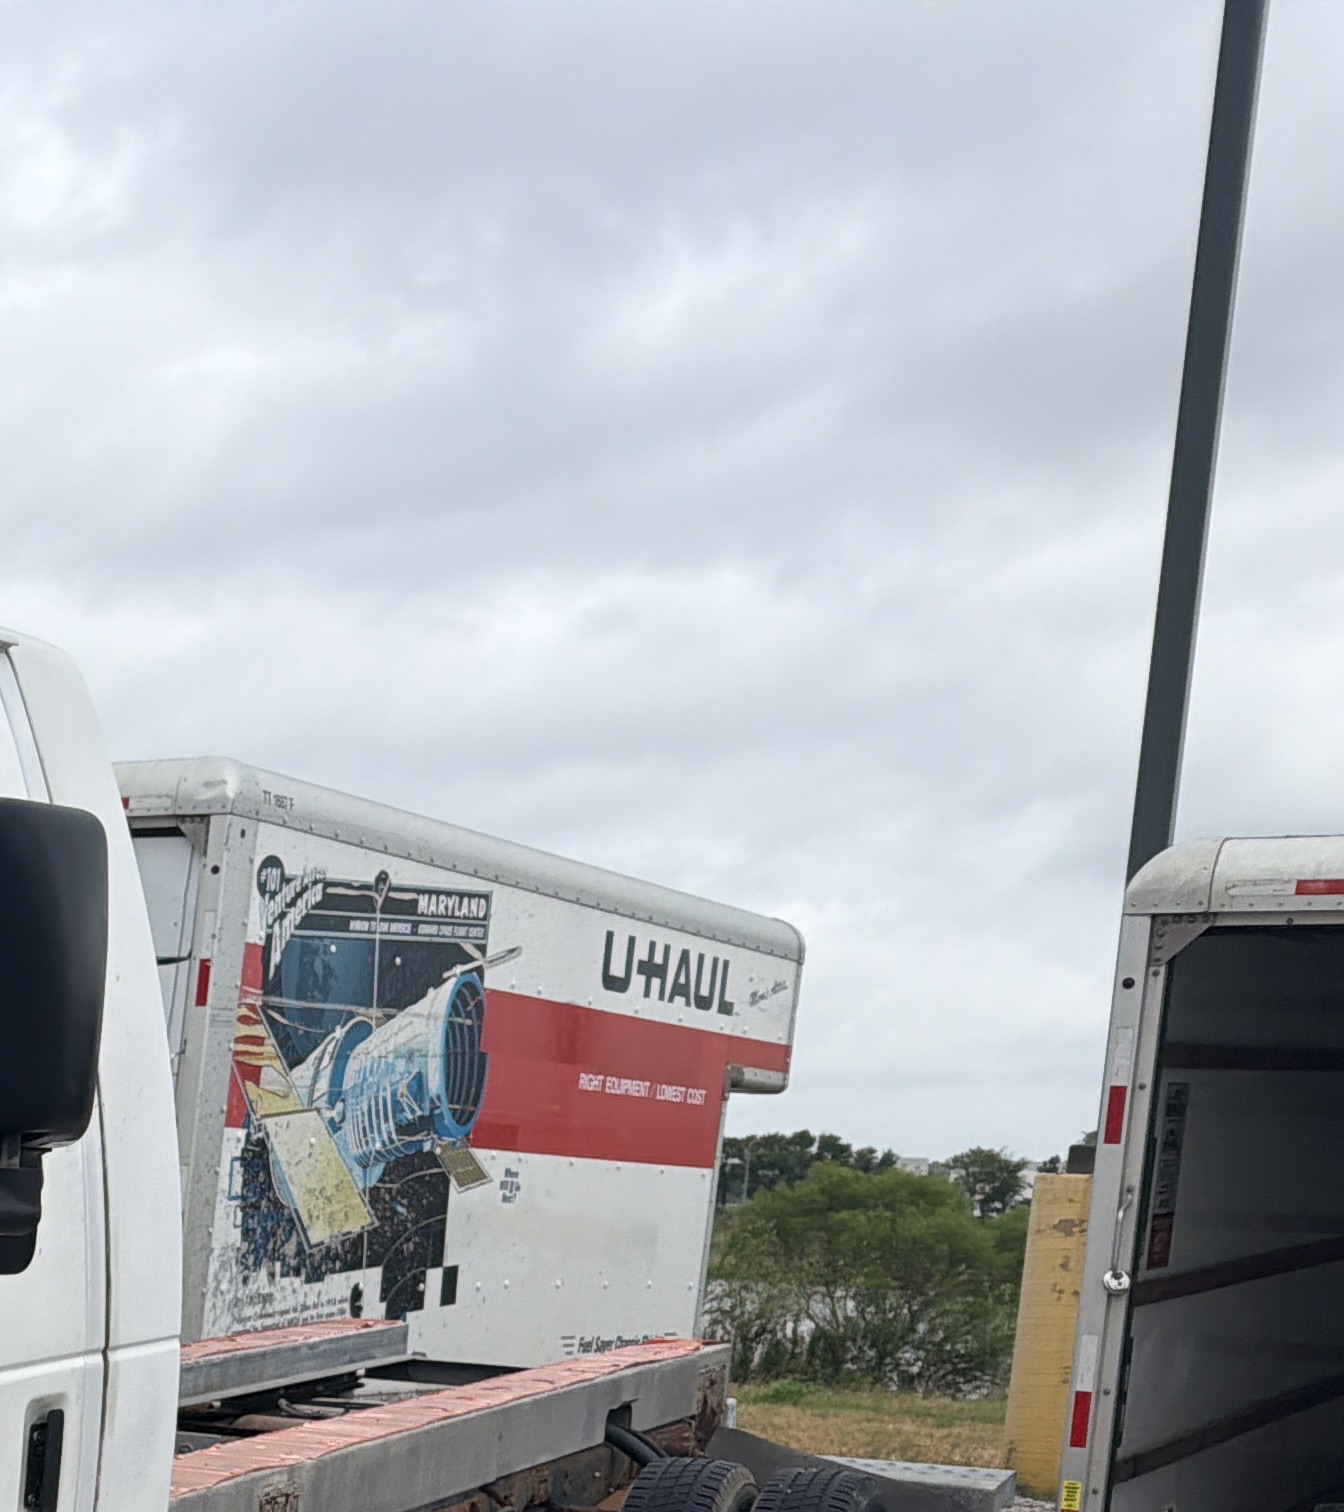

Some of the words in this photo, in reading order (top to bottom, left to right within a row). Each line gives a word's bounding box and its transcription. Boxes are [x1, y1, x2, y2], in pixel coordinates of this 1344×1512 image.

[417, 892, 487, 919] MARYLAND
[578, 1072, 605, 1092] RIGHT
[605, 1075, 651, 1098] EQUIPMENT
[656, 1083, 687, 1103] LOWEST
[686, 1087, 707, 1106] COST
